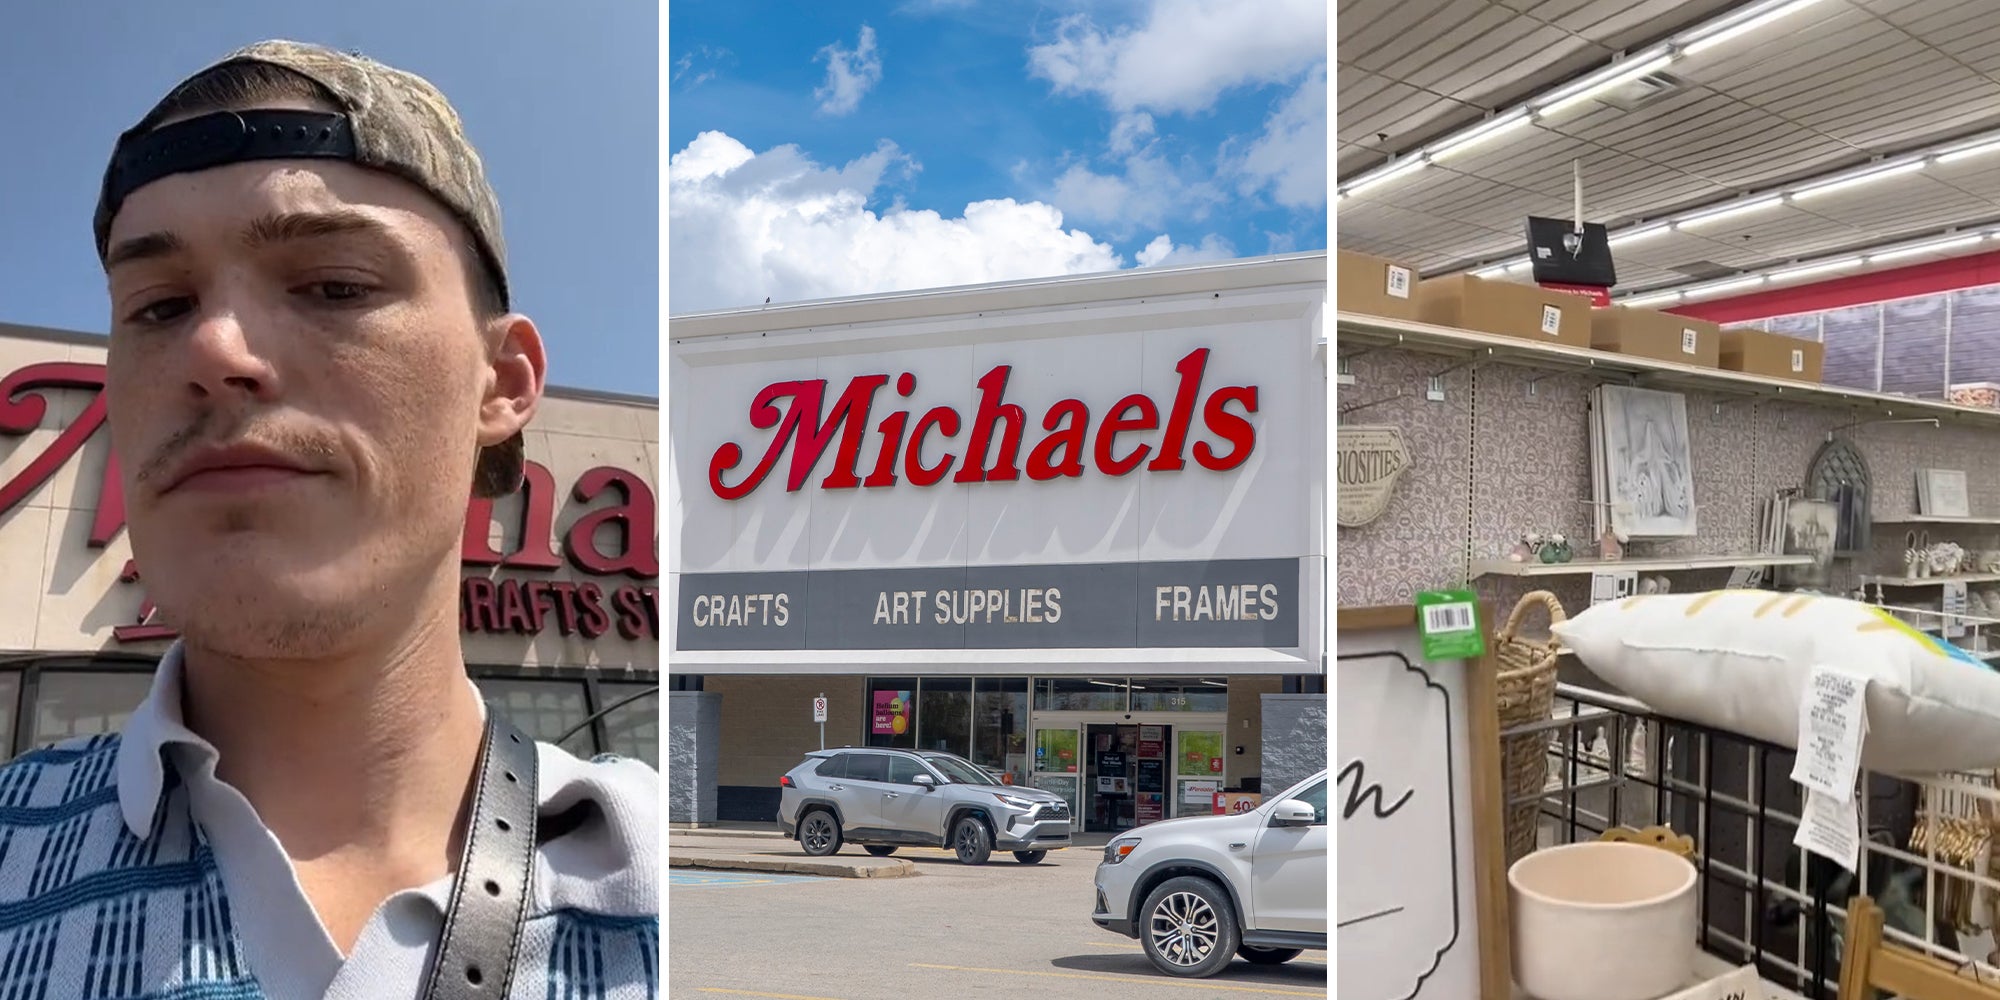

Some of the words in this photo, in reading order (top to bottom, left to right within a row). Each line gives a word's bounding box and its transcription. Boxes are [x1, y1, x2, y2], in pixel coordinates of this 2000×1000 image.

[709, 348, 1259, 500] Michaels
[461, 577, 610, 639] RAFTS
[693, 594, 789, 628] CRAFTS
[873, 591, 927, 626] ART
[935, 588, 1063, 625] SUPPLIES
[1155, 584, 1280, 622] FRAMES
[1171, 697, 1186, 706] 315
